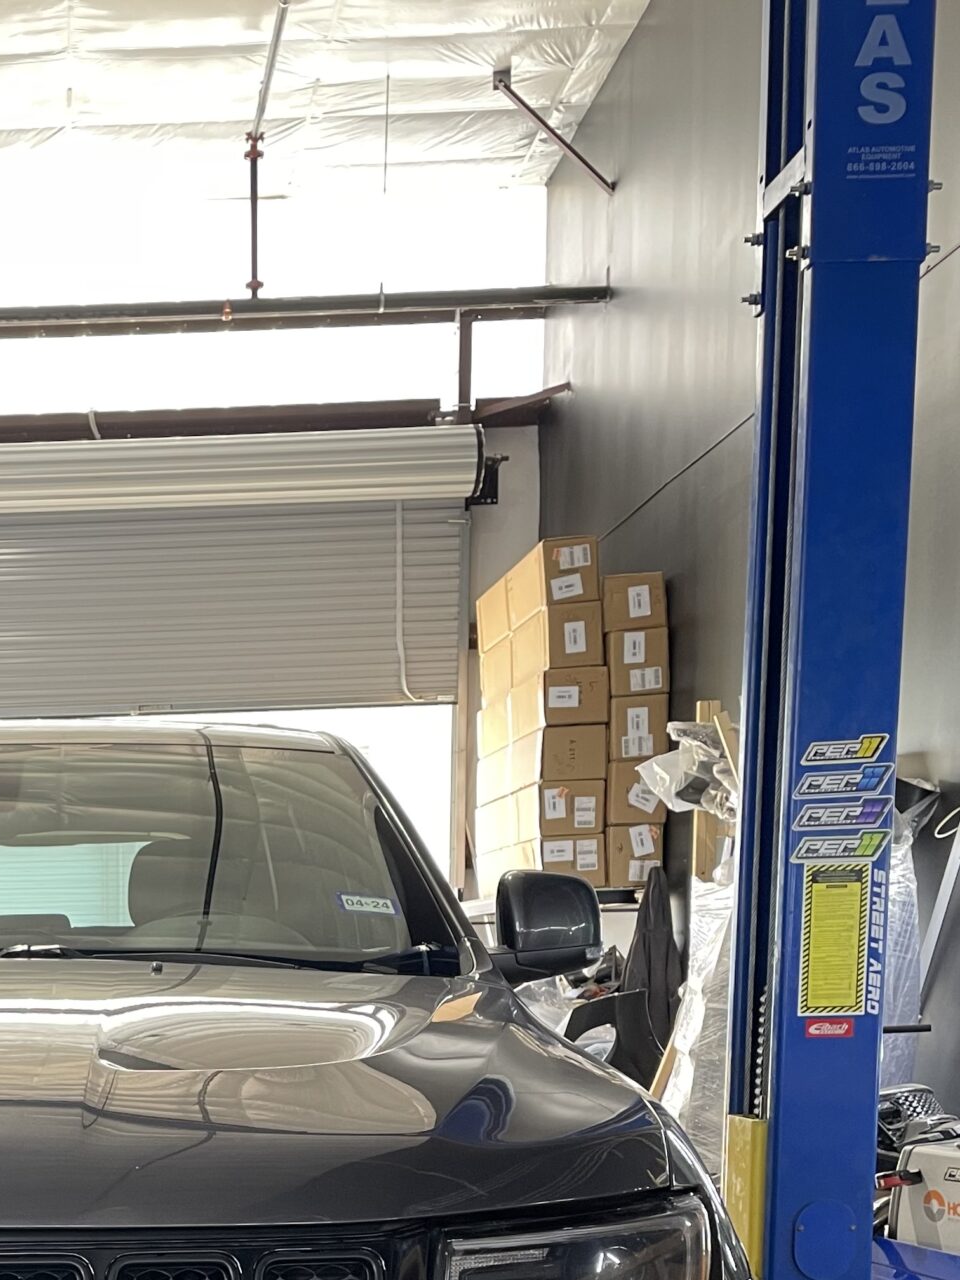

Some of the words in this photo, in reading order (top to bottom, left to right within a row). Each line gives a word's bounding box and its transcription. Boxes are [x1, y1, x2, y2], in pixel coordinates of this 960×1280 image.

[854, 0, 912, 124] AS
[345, 898, 390, 909] 04-24
[870, 868, 886, 953] STREET
[866, 958, 882, 1015] AERO
